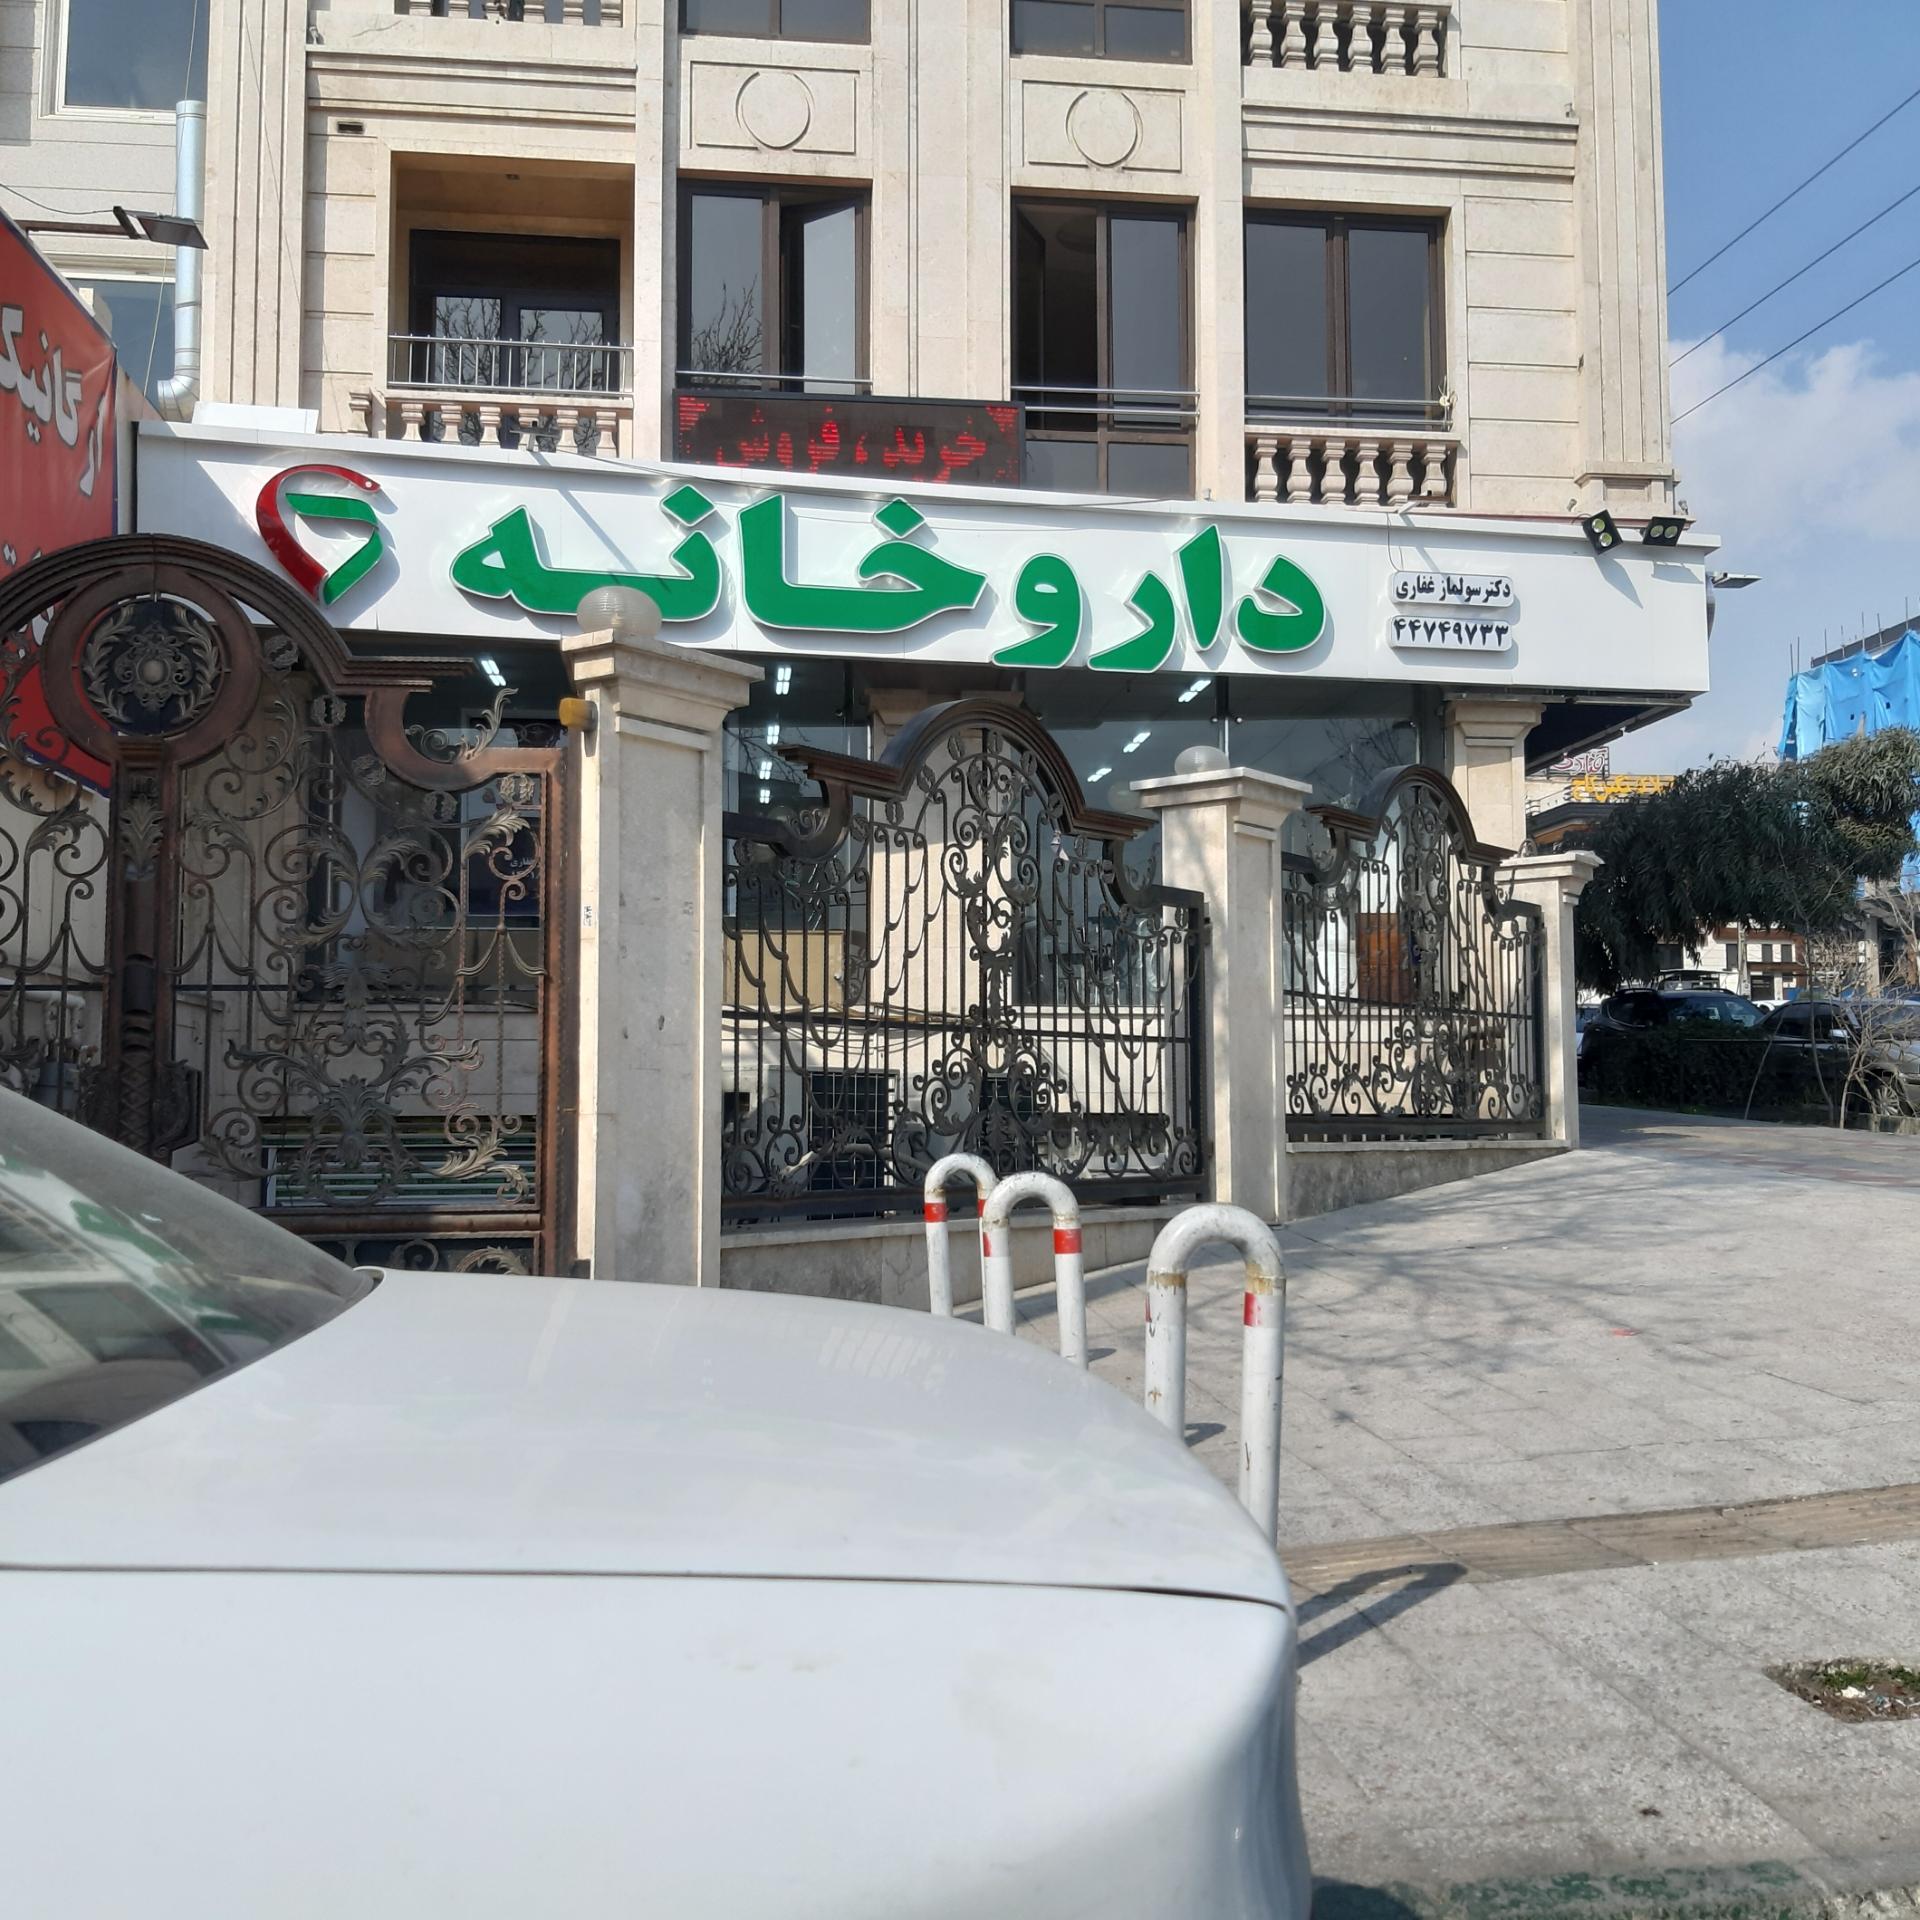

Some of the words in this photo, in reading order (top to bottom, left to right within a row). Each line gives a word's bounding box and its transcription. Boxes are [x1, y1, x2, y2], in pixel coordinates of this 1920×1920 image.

[449, 484, 1328, 673] داروخانه
[1396, 574, 1435, 600] غفاری
[1439, 575, 1481, 602] سولماز
[1482, 579, 1511, 603] دکتر
[1393, 617, 1509, 647] ۴۴۷۴۹۷۳۳
